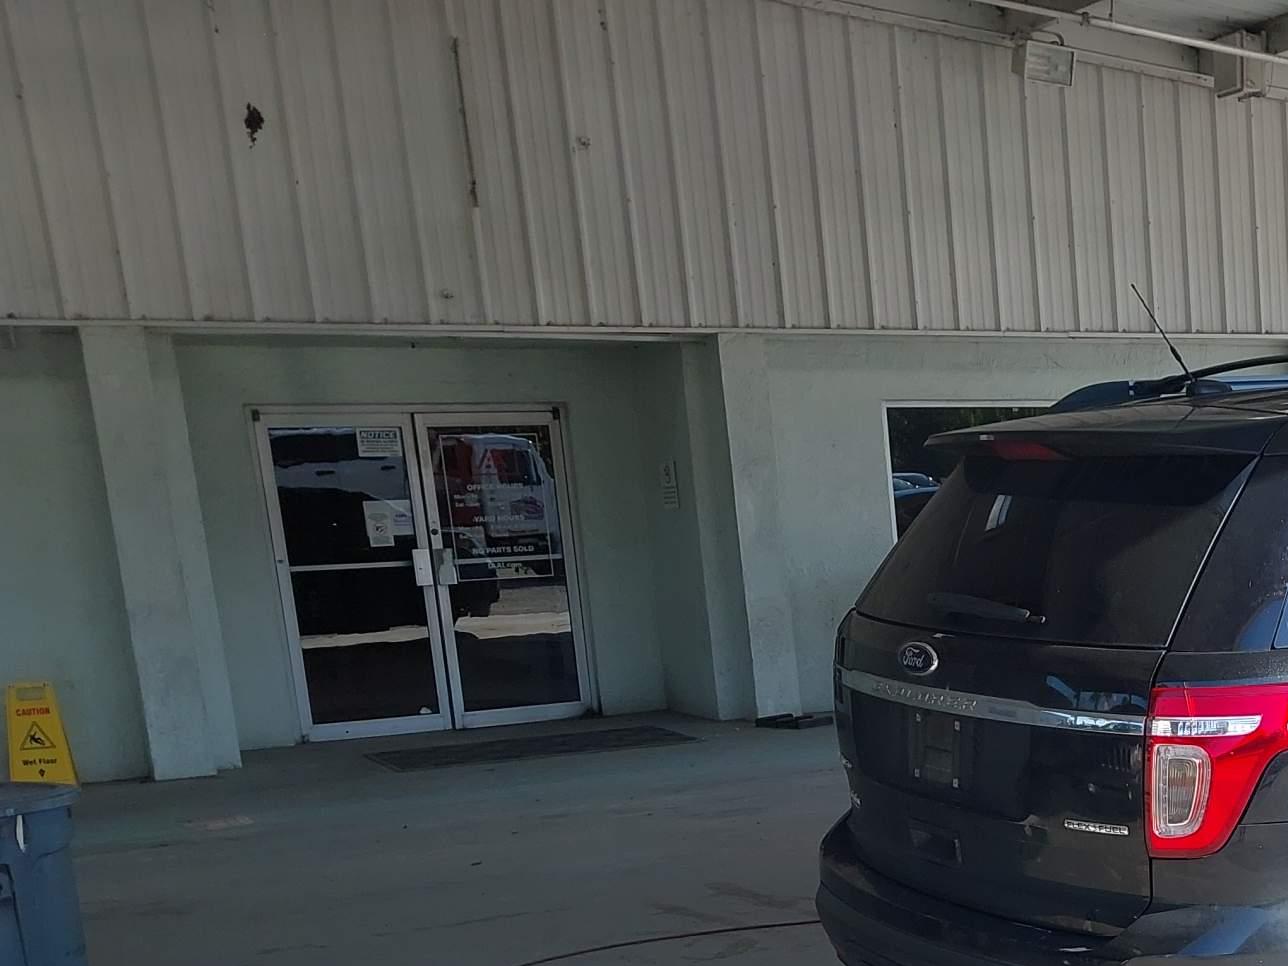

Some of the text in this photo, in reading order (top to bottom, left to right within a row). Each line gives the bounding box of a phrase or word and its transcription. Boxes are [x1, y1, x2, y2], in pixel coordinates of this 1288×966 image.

[360, 431, 396, 439] NOTICE
[486, 546, 512, 554] PARTS
[16, 707, 50, 716] CAUTION
